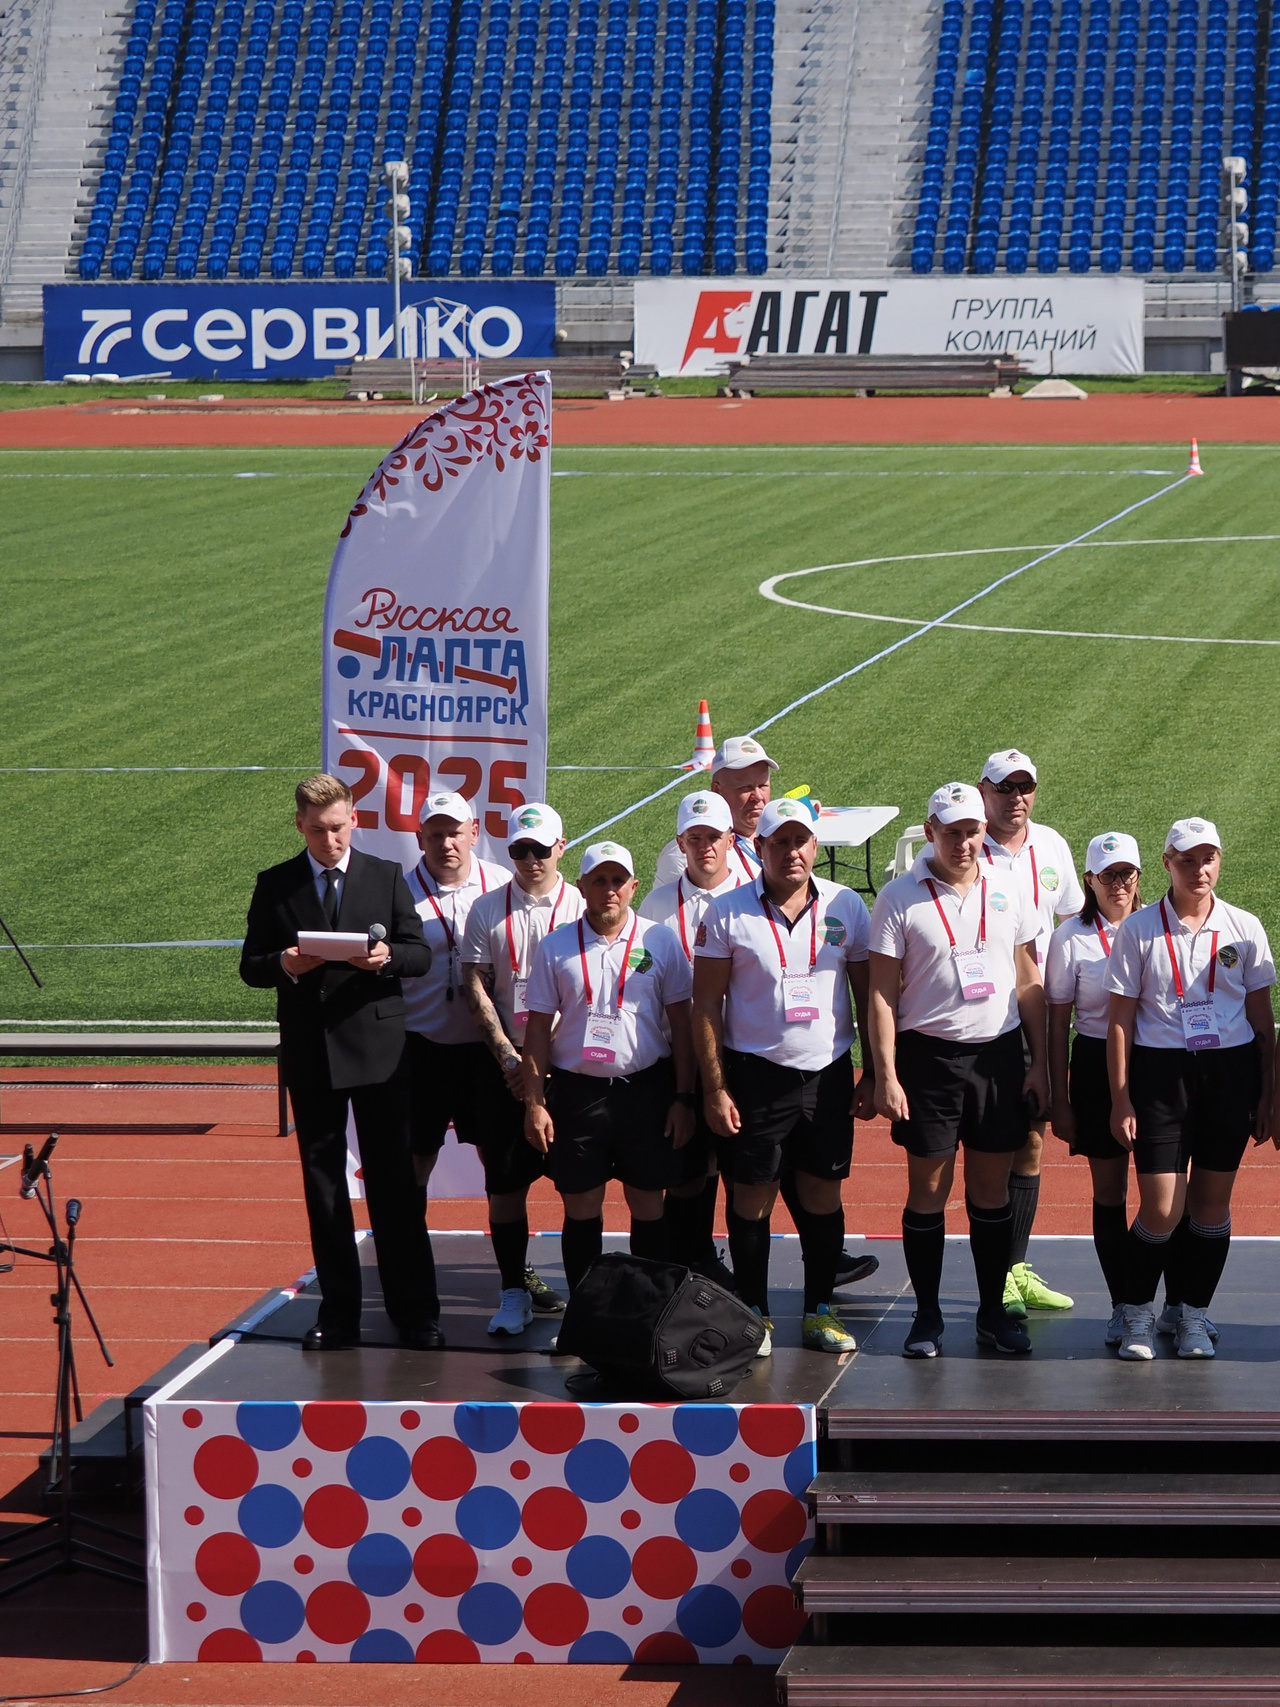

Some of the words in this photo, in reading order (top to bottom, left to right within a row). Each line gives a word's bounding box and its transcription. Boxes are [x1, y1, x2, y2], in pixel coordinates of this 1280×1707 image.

[746, 290, 888, 354] АГАТ
[951, 298, 1054, 320] ГРУППА
[945, 324, 1098, 352] КОМПАНИЙ
[354, 587, 519, 633] Русская
[373, 635, 529, 705] ЛАПТА
[348, 689, 527, 726] КРАСНОЯРСК
